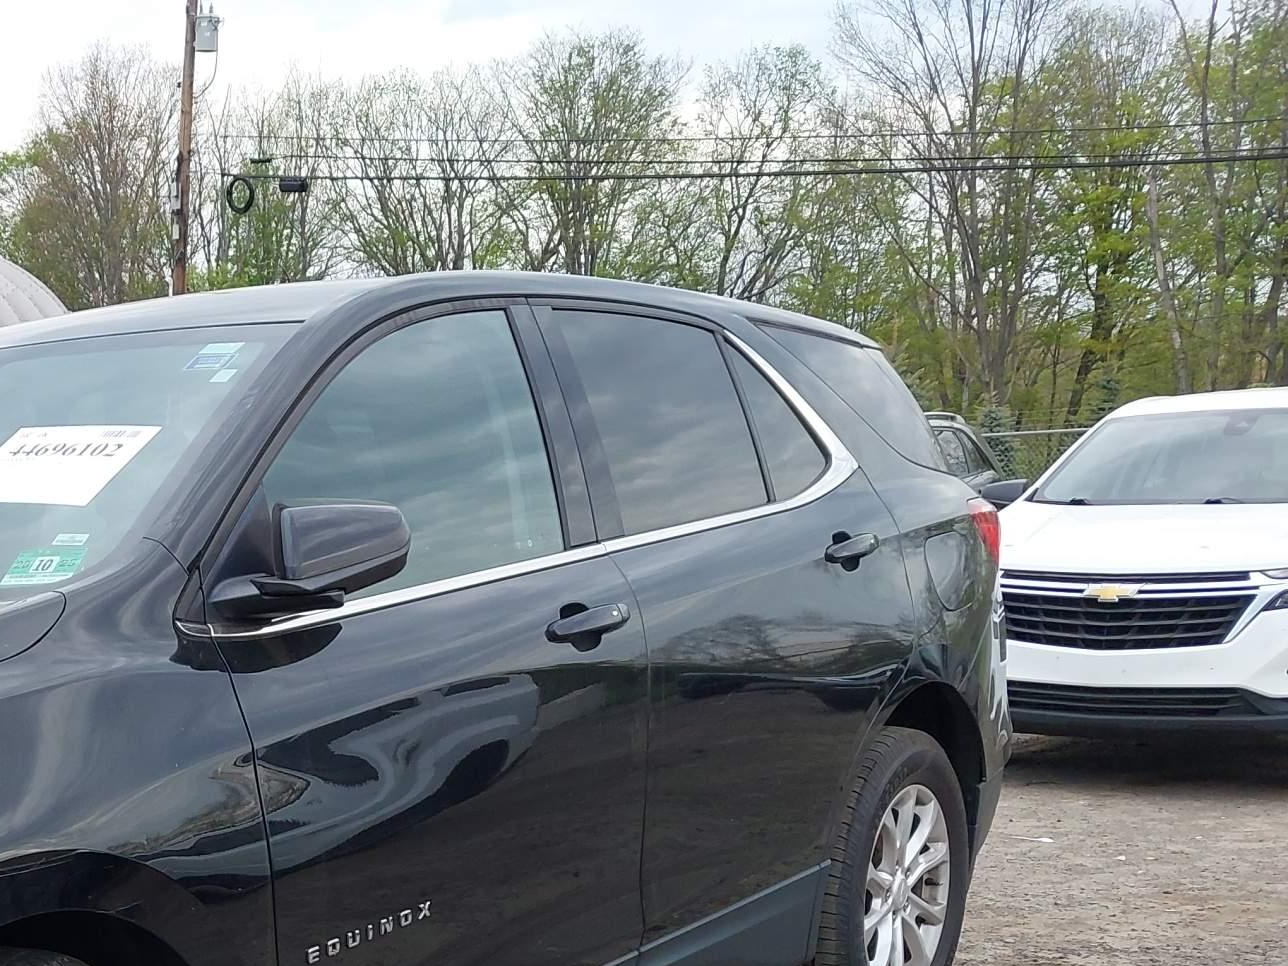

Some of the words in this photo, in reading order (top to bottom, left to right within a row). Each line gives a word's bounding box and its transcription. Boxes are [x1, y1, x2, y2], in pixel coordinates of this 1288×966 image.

[9, 442, 124, 457] 44696102
[31, 559, 54, 572] 10
[307, 900, 432, 964] EQUINOX
